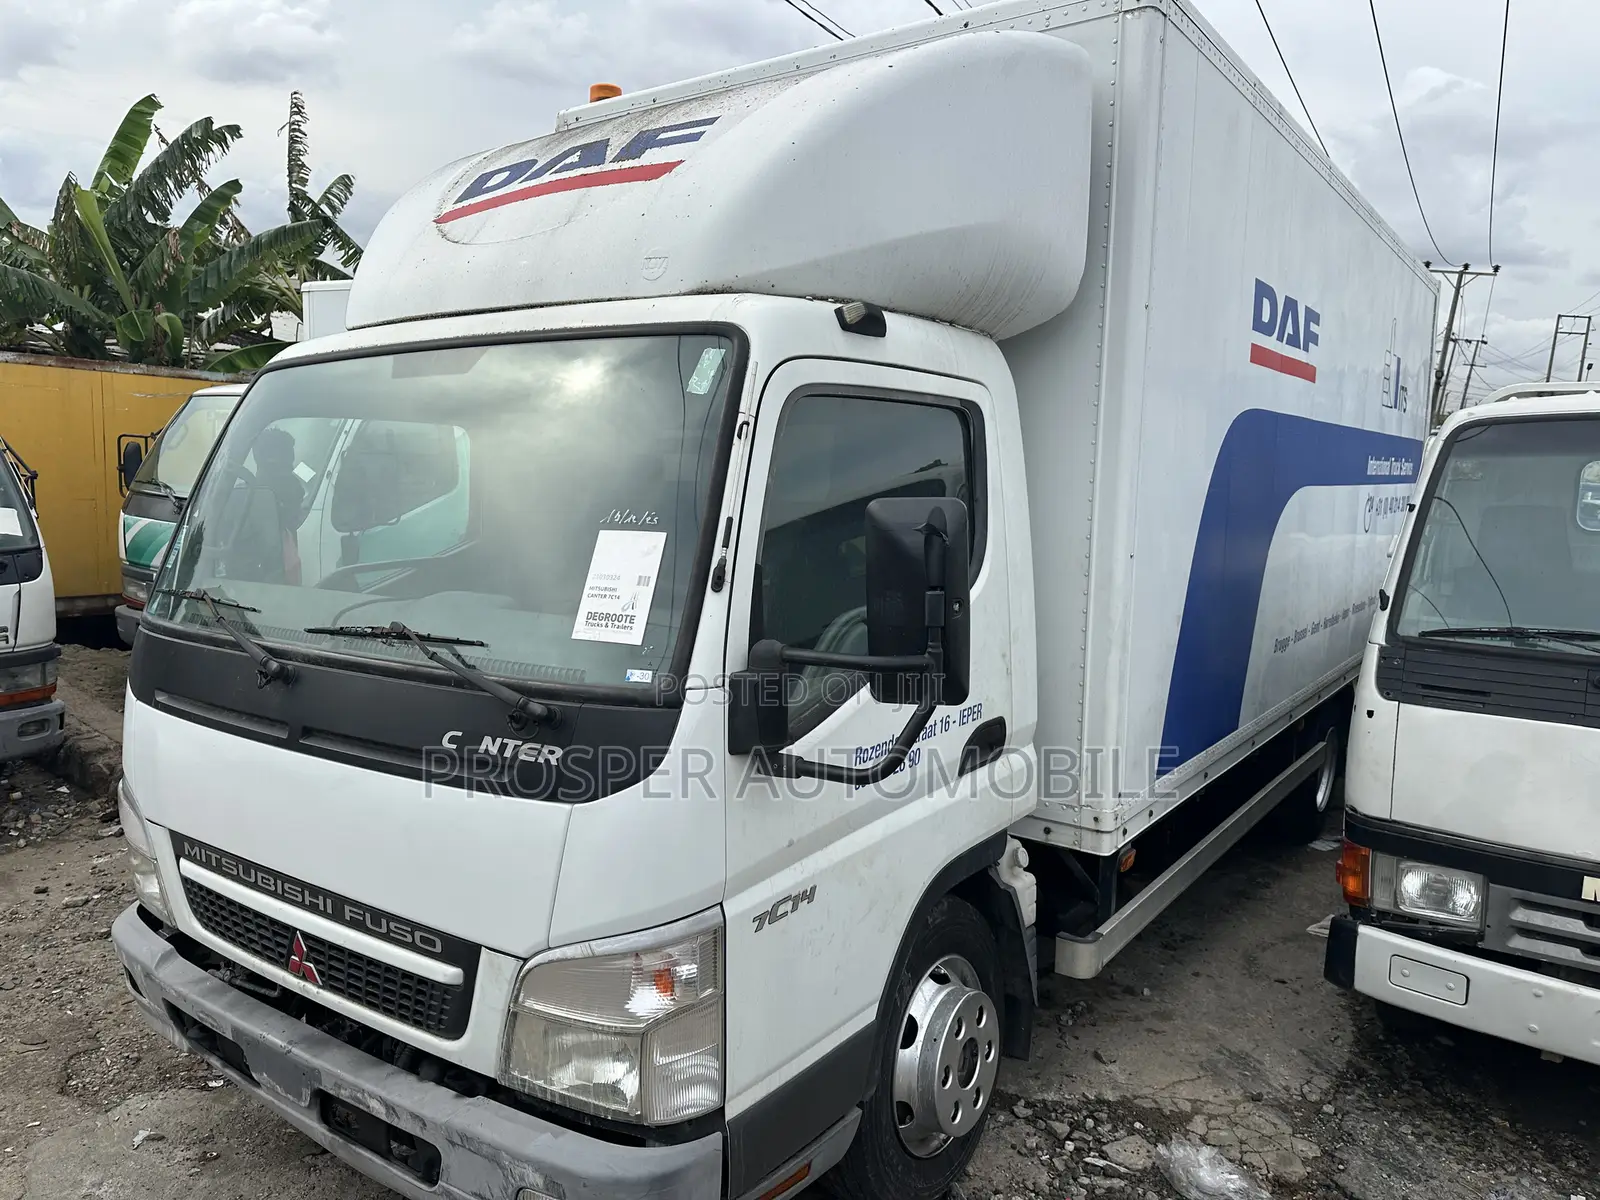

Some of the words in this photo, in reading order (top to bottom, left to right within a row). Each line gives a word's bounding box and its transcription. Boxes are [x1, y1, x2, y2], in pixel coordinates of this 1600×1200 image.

[453, 115, 721, 204] DAF
[1252, 277, 1320, 353] DAF
[588, 585, 617, 593] MITSUBISHI
[585, 621, 604, 629] Trucks
[610, 622, 633, 631] Trailers
[586, 611, 636, 624] DEGROOTE
[1274, 636, 1290, 654] Brugge
[940, 715, 950, 734] 16
[958, 703, 983, 727] IEPER
[908, 747, 921, 768] 90
[184, 841, 333, 914] MITSUBISHI
[344, 904, 443, 953] FUSO
[752, 884, 817, 933] 7C14
